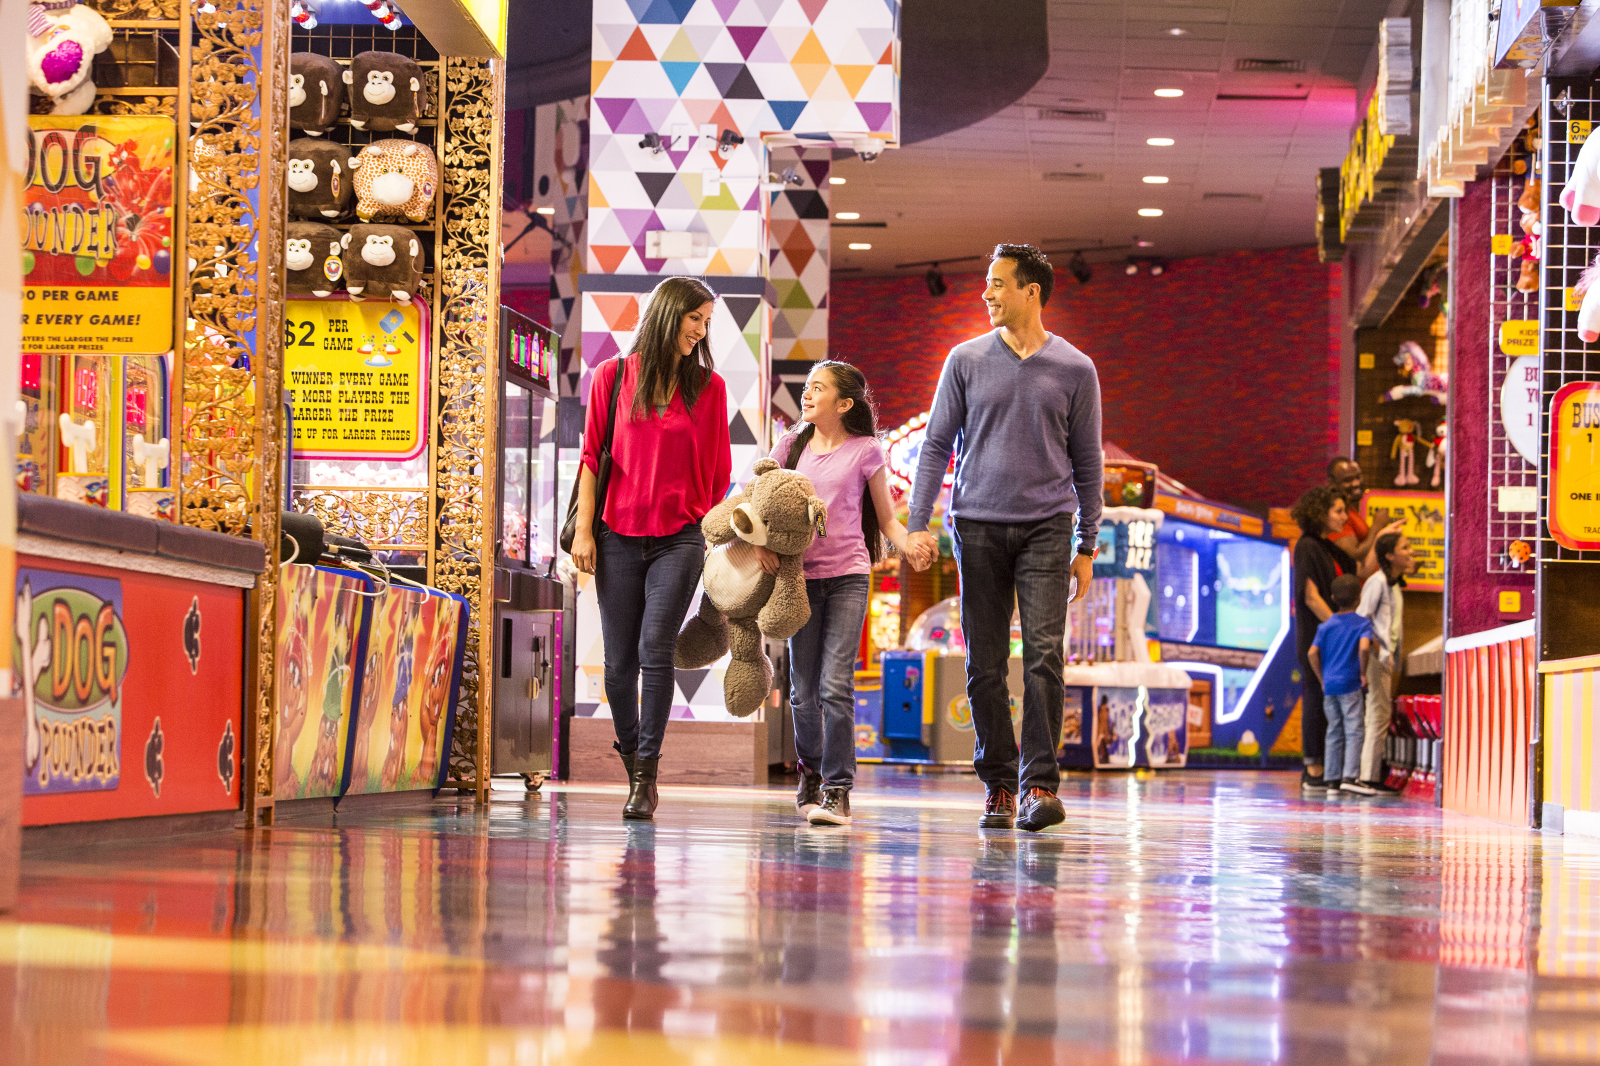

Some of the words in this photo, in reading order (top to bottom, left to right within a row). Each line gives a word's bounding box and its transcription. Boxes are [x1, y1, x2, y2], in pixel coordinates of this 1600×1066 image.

[42, 290, 69, 301] PER
[75, 290, 119, 301] GAME
[35, 314, 84, 325] EVERY
[89, 314, 141, 325] GAME!
[328, 319, 349, 333] PER
[284, 318, 316, 349] $2
[323, 337, 353, 351] GAME
[1506, 338, 1536, 347] PRIZE
[291, 371, 334, 385] WINNER
[339, 372, 374, 386] EVERY
[379, 372, 409, 386] GAME
[302, 389, 332, 403] MORE
[338, 390, 385, 404] PLAYERS
[390, 391, 410, 404] THE
[292, 407, 333, 421] LARGER
[338, 408, 358, 422] THE
[364, 409, 394, 422] PRIZE
[1527, 412, 1534, 427] 1
[306, 428, 318, 439] UP
[322, 428, 338, 440] FOR
[343, 429, 376, 440] LARGER
[381, 429, 411, 441] PRIZES
[1570, 492, 1592, 501] ONE
[53, 598, 118, 708] DOG
[38, 713, 120, 788] POUNDER
